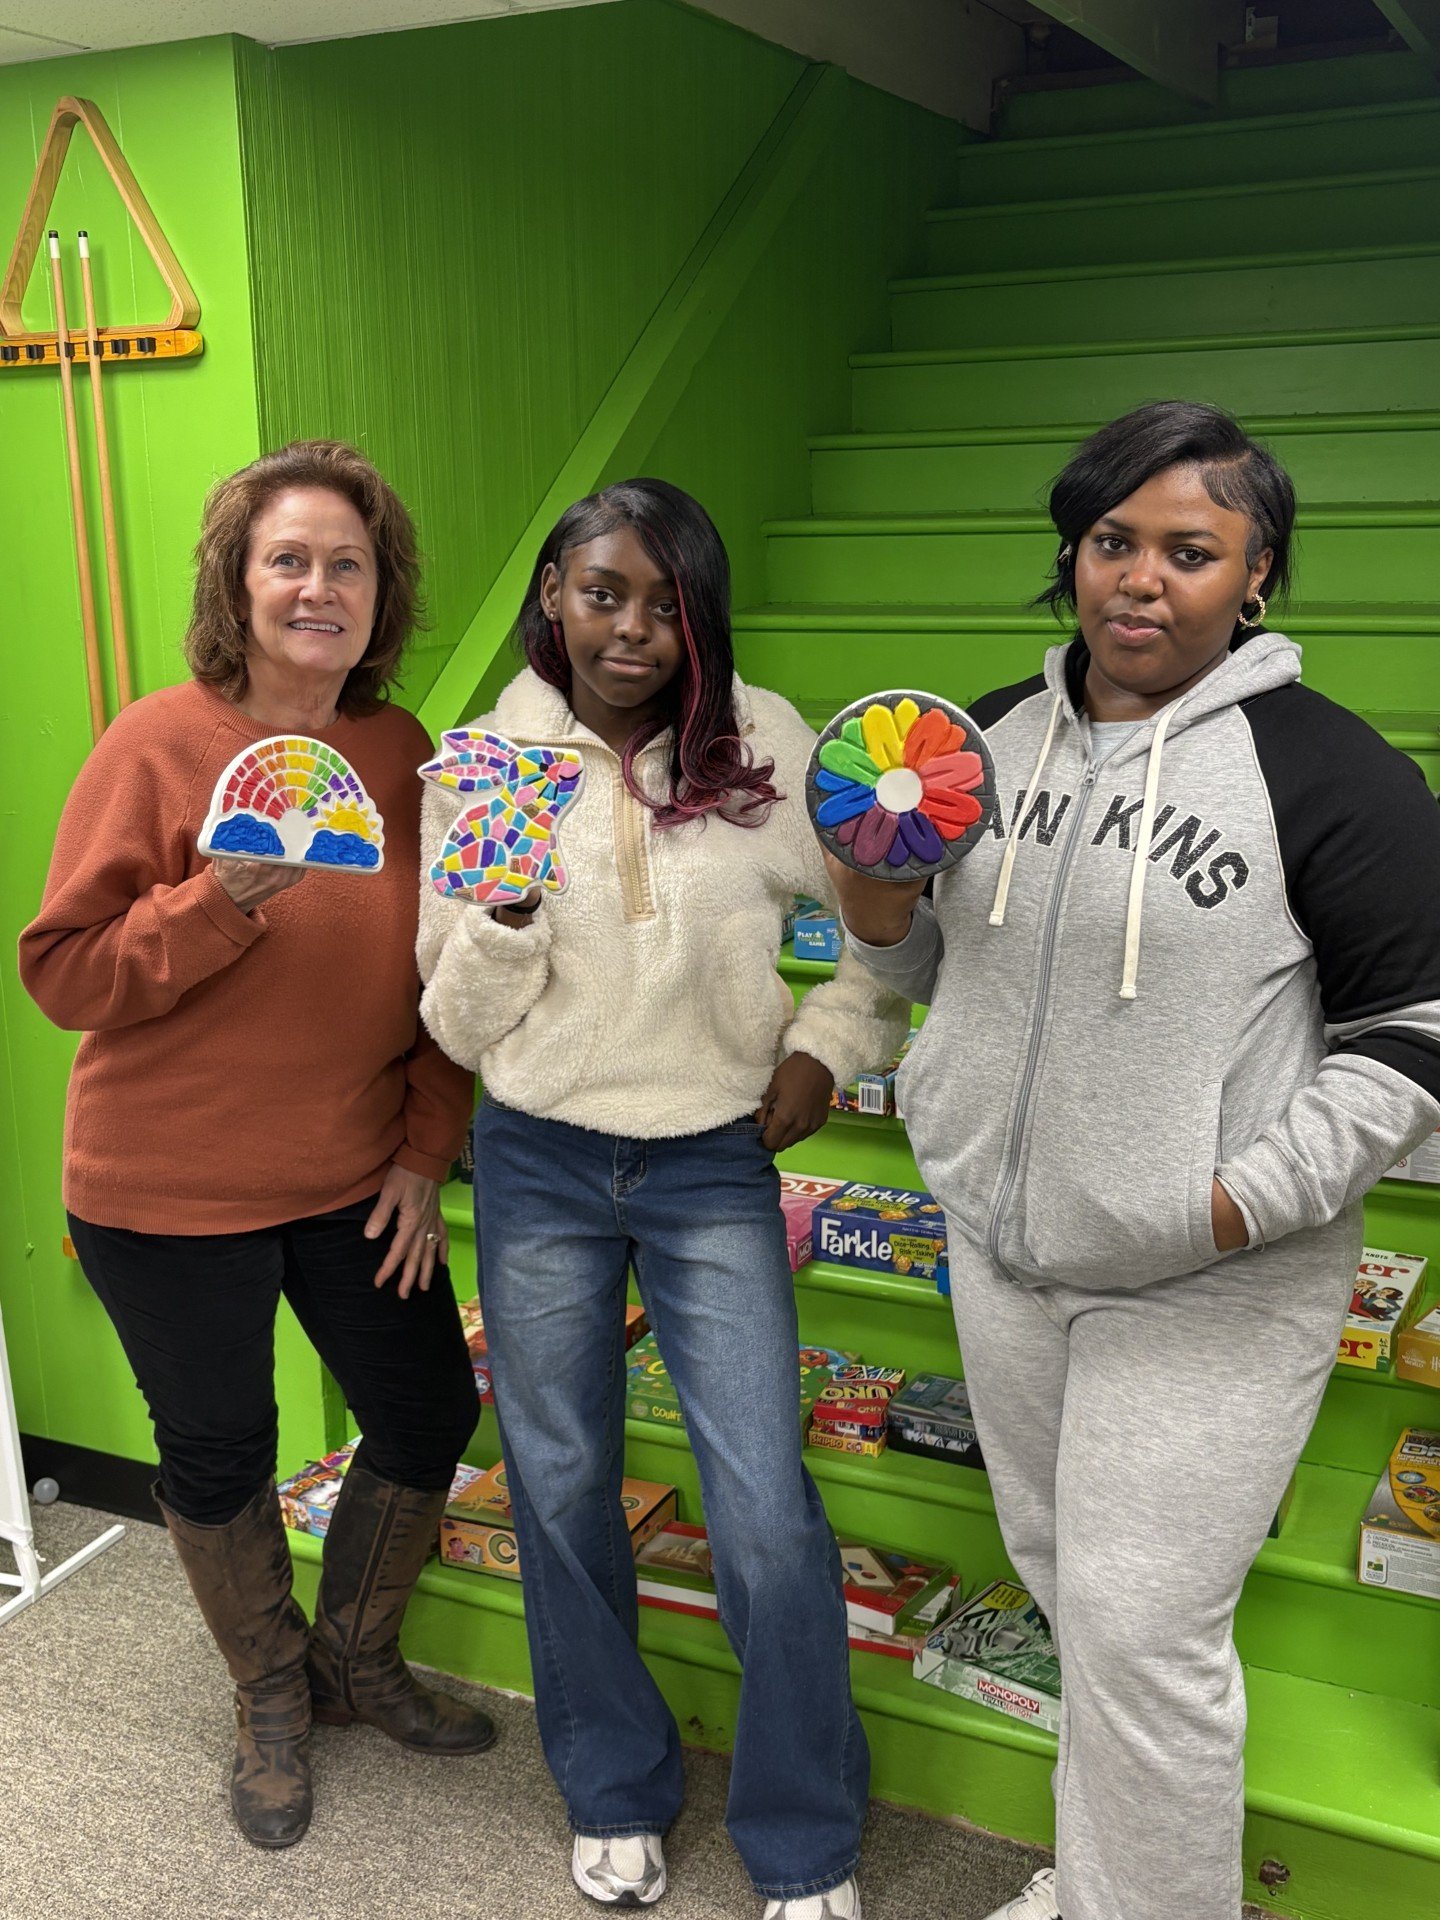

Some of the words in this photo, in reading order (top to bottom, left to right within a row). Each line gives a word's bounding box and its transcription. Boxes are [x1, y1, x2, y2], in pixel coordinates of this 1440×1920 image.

[797, 931, 813, 940] PLAY
[843, 1183, 921, 1205] Farkle
[820, 1217, 893, 1261] Farkle
[818, 1385, 889, 1400] UNO
[652, 1406, 682, 1422] COUNT
[978, 1680, 1038, 1711] MONOPOLY
